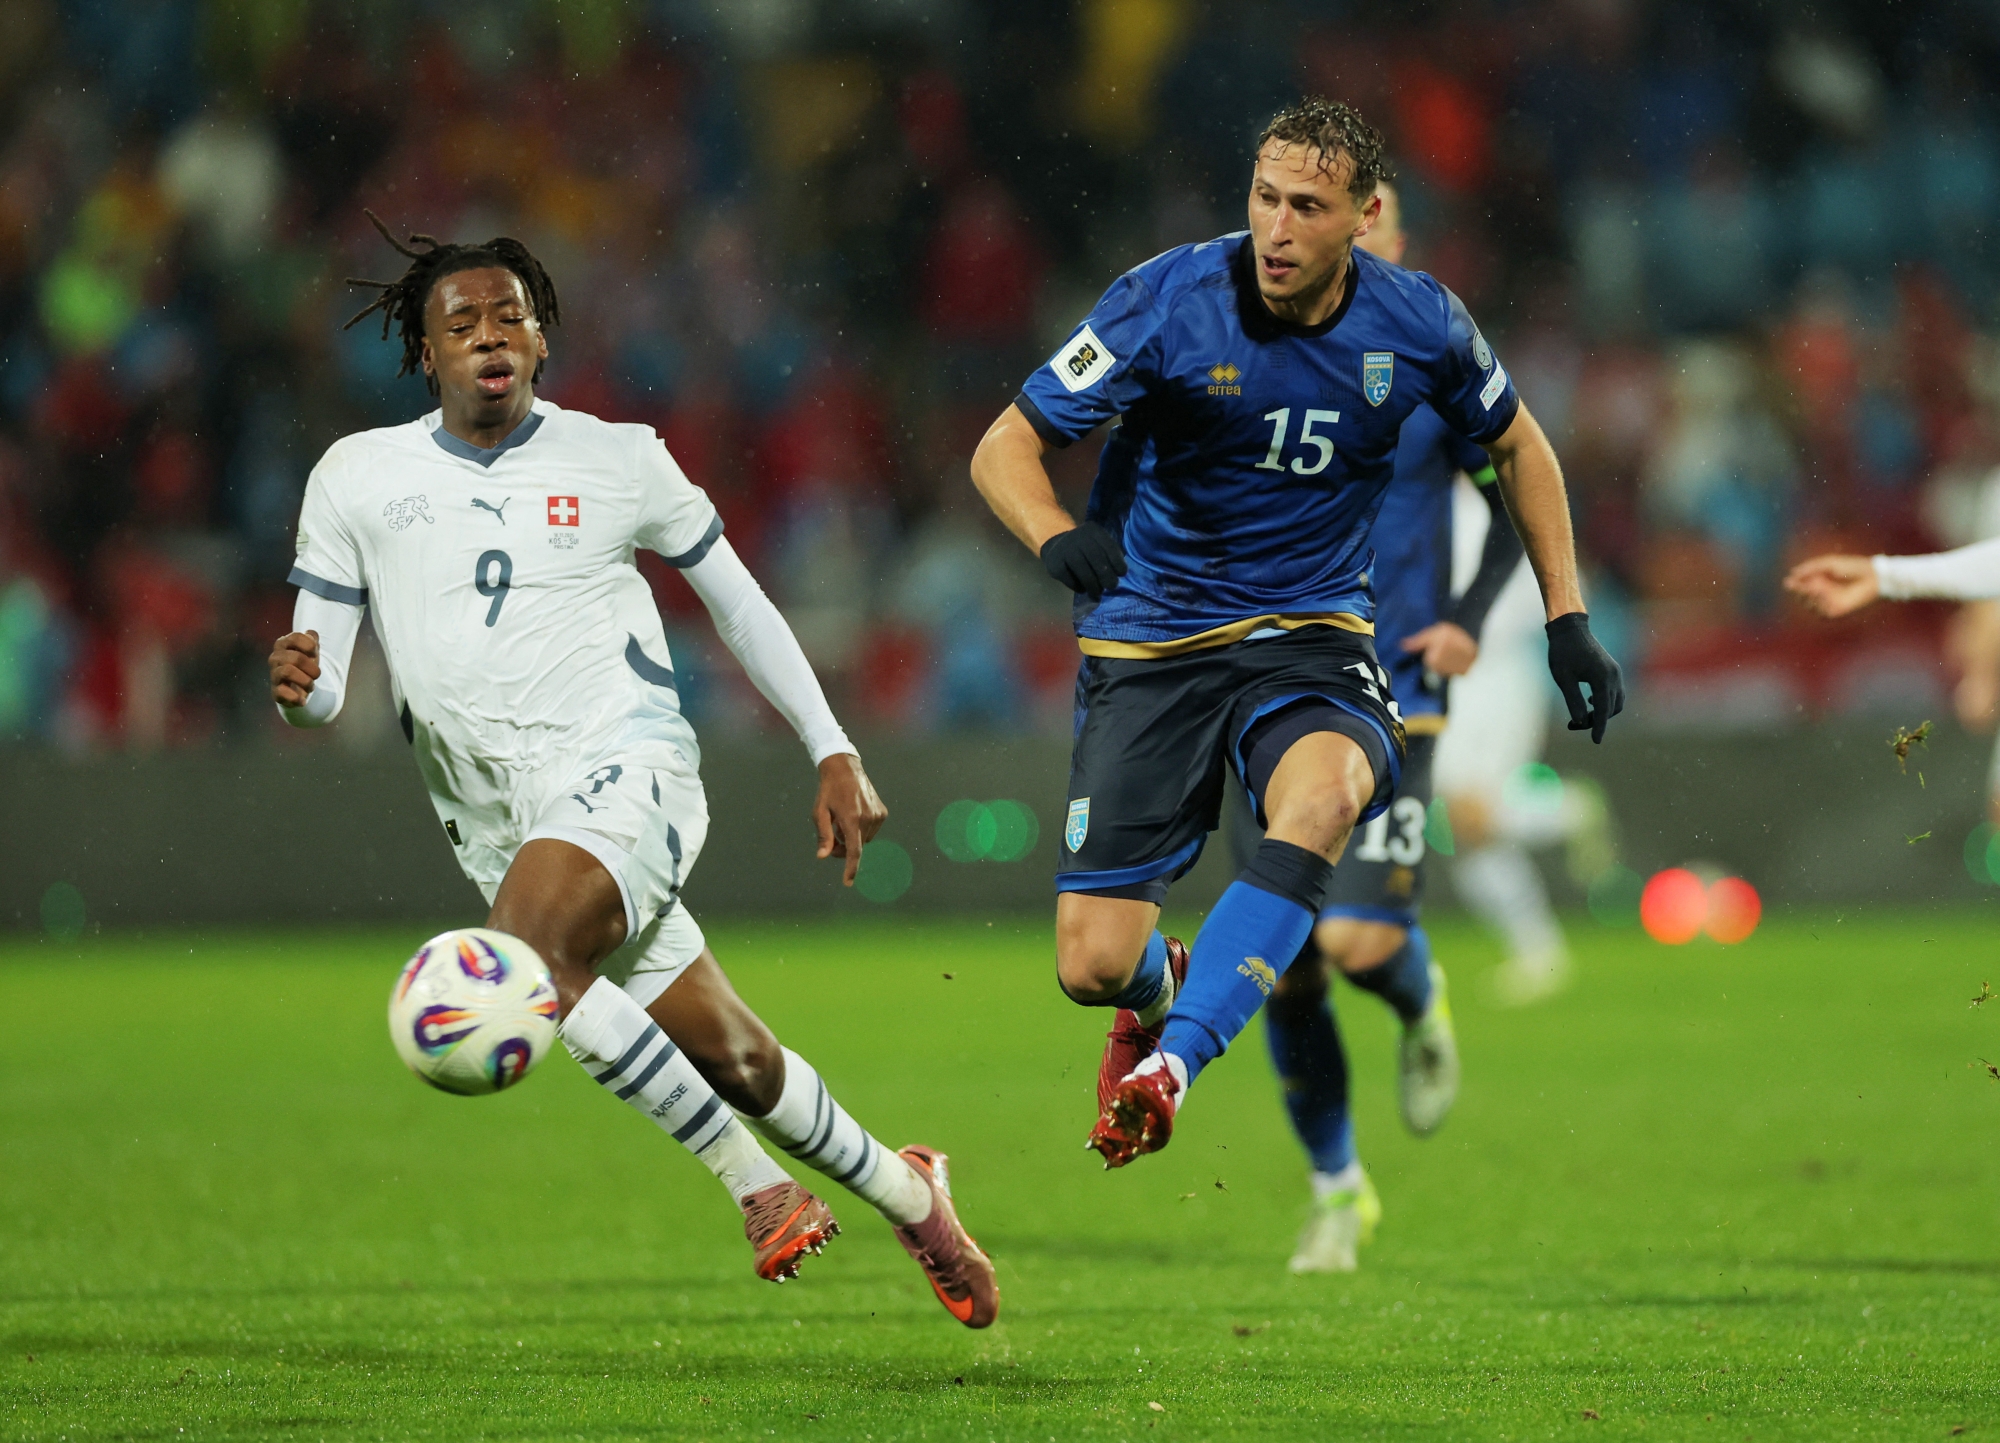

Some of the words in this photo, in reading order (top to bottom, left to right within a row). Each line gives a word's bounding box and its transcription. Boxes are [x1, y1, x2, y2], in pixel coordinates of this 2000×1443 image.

[1254, 407, 1341, 475] 15
[548, 537, 562, 545] KOS
[569, 537, 580, 545] SUI
[475, 549, 513, 628] 9
[1354, 796, 1426, 867] 13
[651, 1082, 689, 1118] SUISSE
